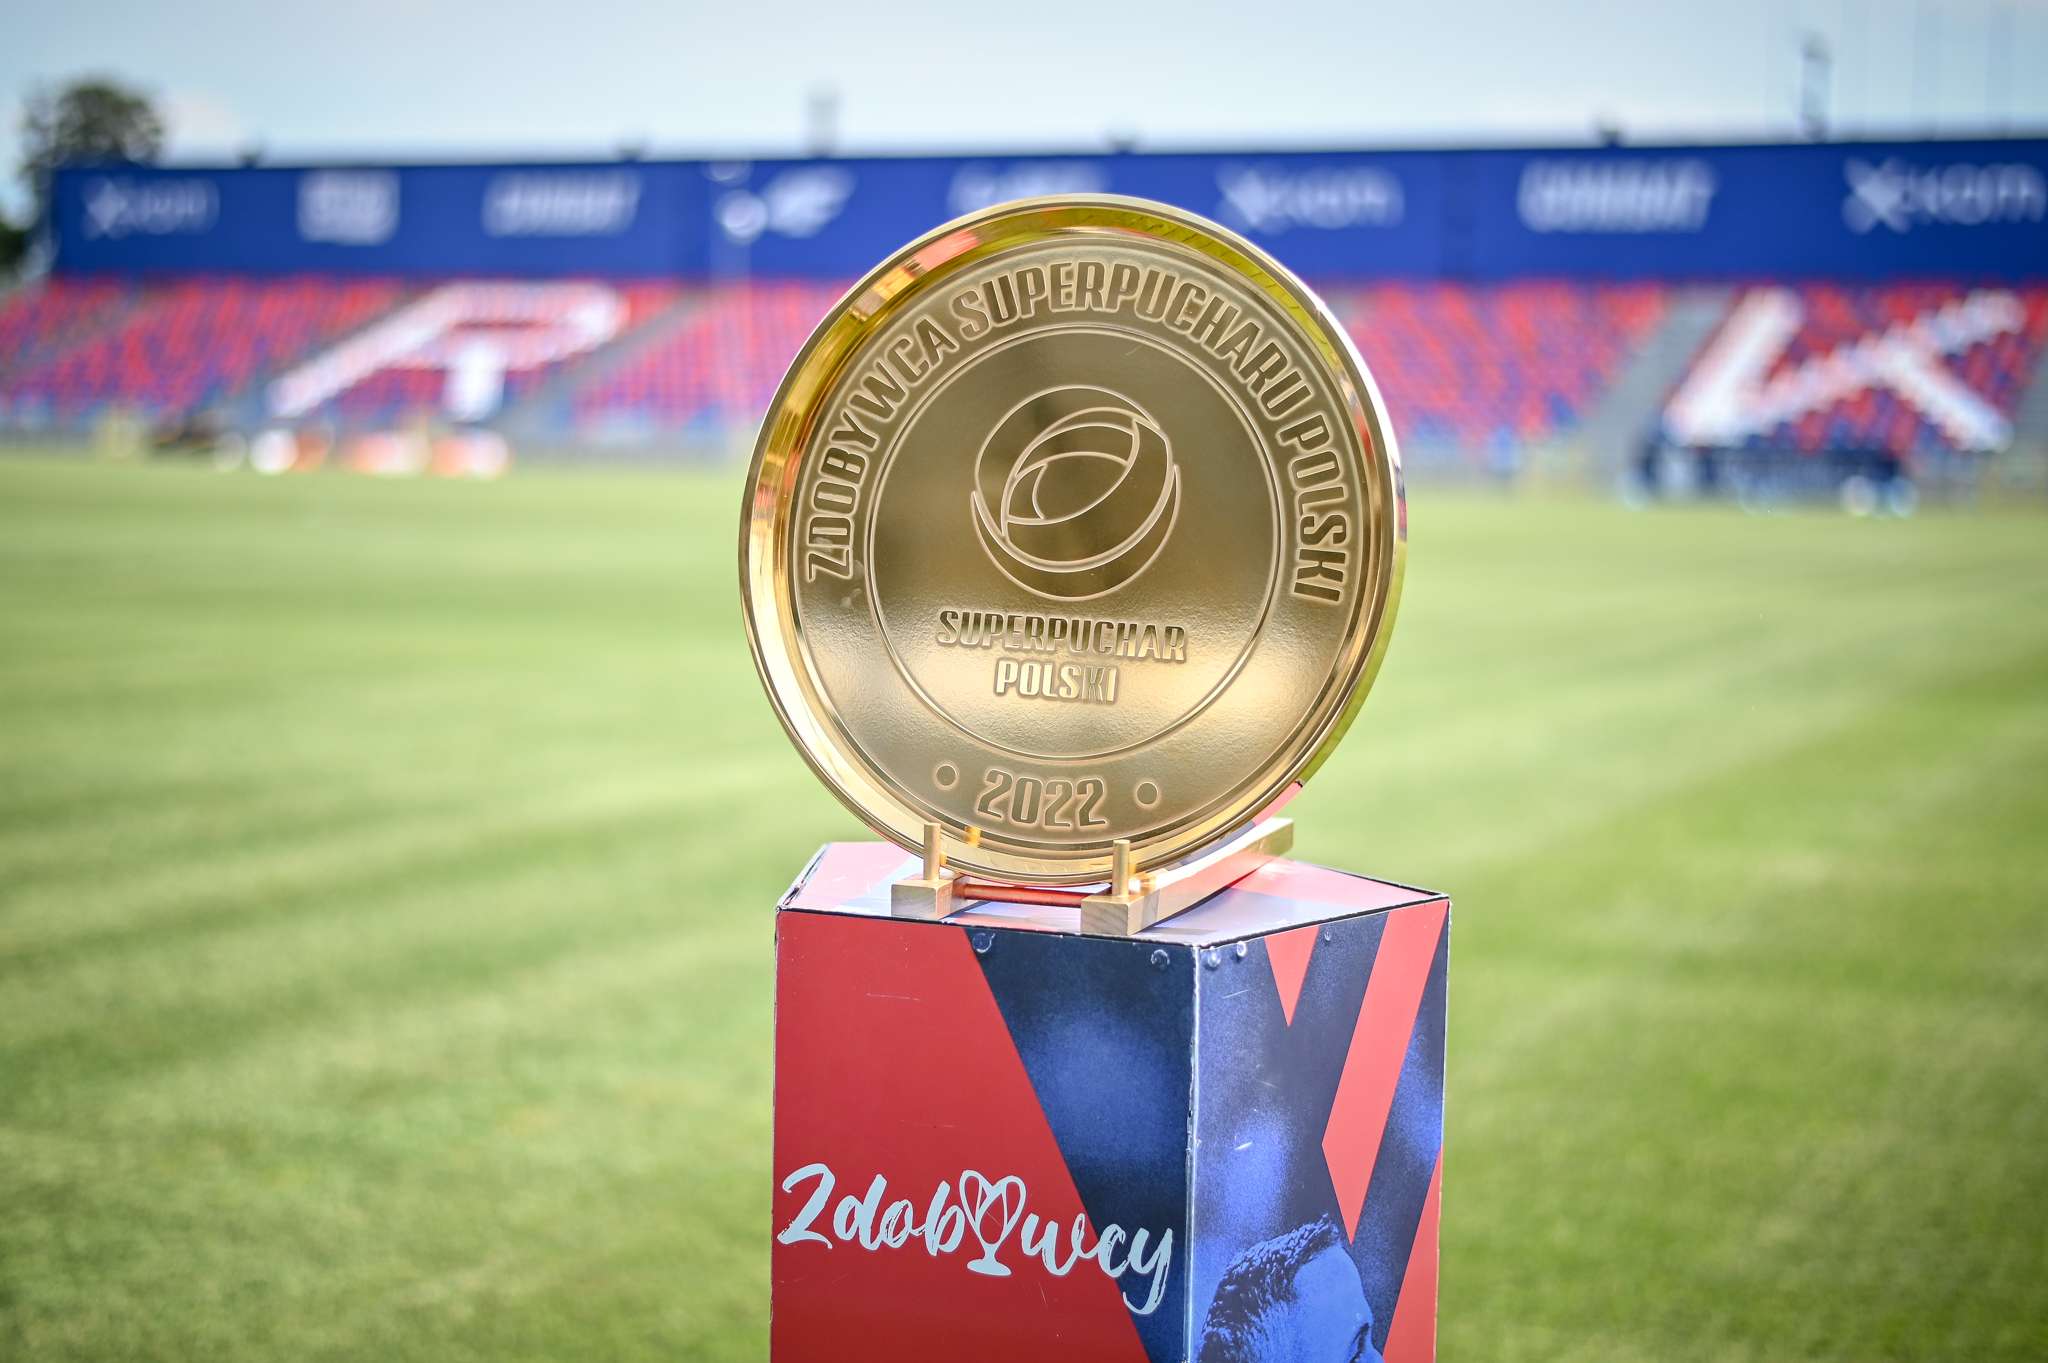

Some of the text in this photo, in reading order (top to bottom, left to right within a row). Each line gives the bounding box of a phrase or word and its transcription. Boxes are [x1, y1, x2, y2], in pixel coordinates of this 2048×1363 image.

[806, 260, 1348, 604] ZDOBYWCA SUPERPUCHARU POLSKI
[937, 608, 1187, 663] SUPERPUCHAR
[994, 658, 1119, 704] POLSKI
[976, 768, 1108, 830] 2022
